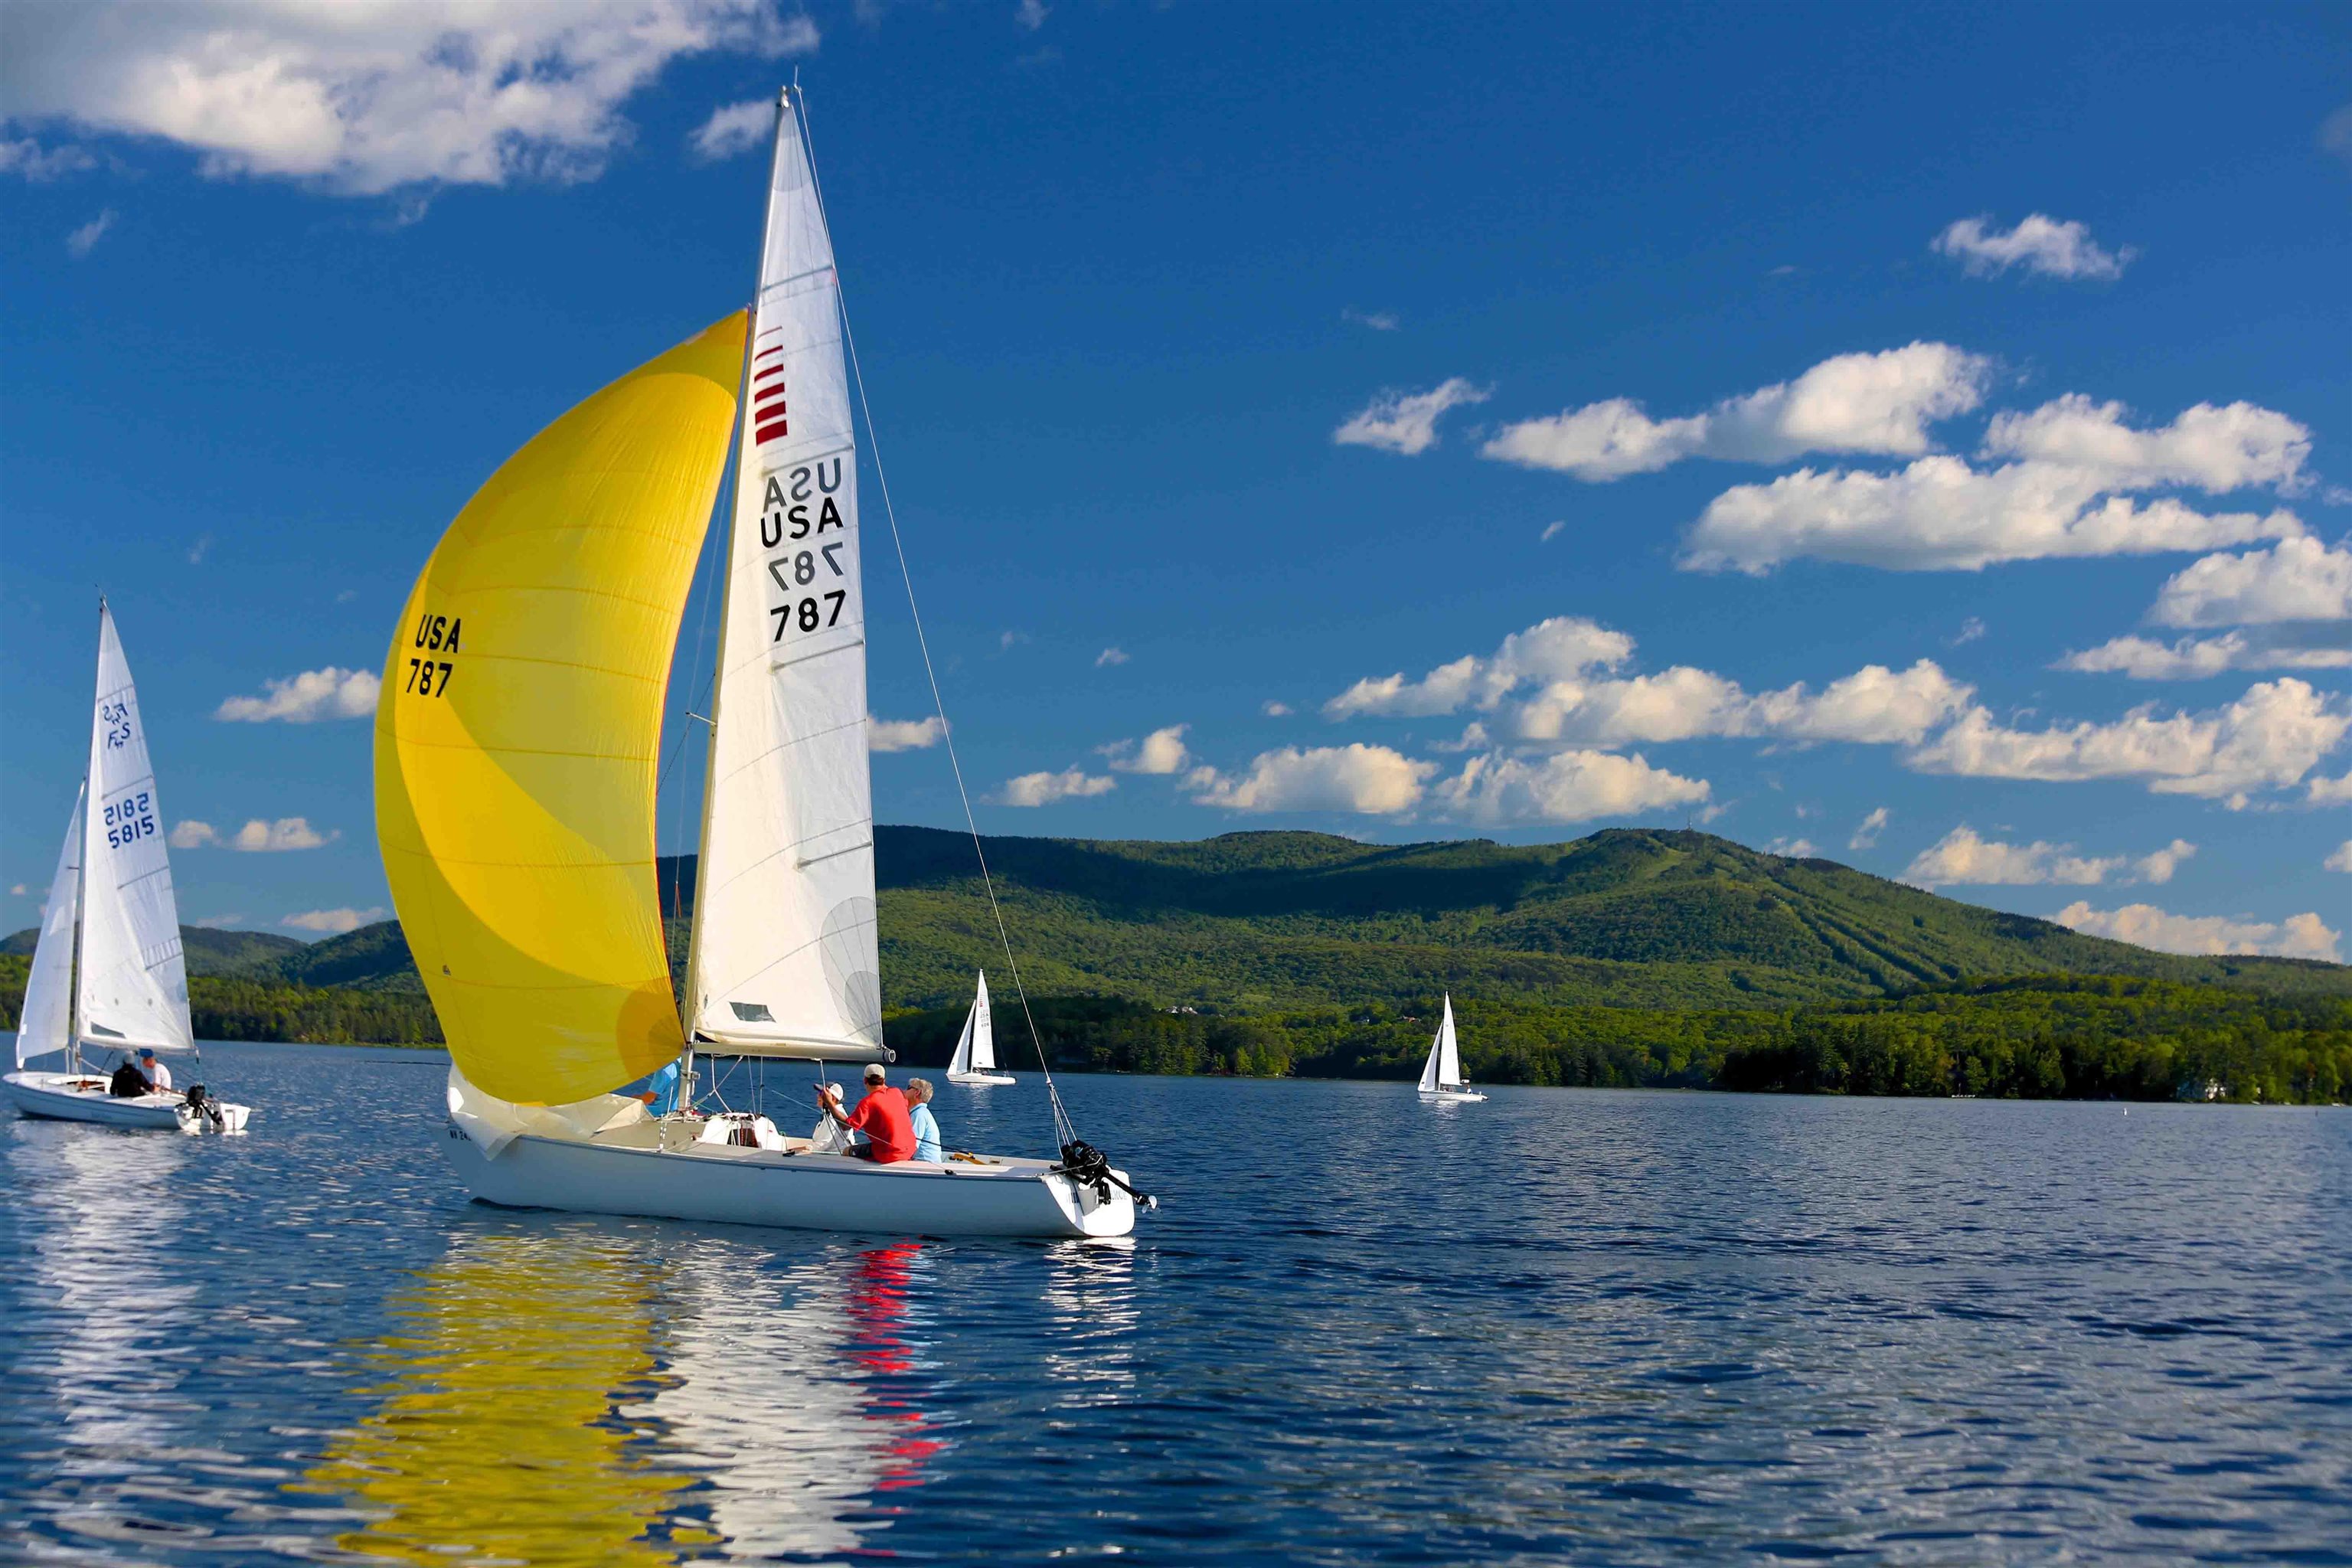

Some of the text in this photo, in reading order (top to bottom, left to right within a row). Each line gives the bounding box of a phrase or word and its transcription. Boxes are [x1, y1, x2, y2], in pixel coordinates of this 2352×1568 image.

[760, 497, 844, 548] USA
[416, 614, 461, 654] USA
[770, 590, 846, 642] 787
[406, 658, 453, 698] 787
[108, 815, 155, 849] 5815
